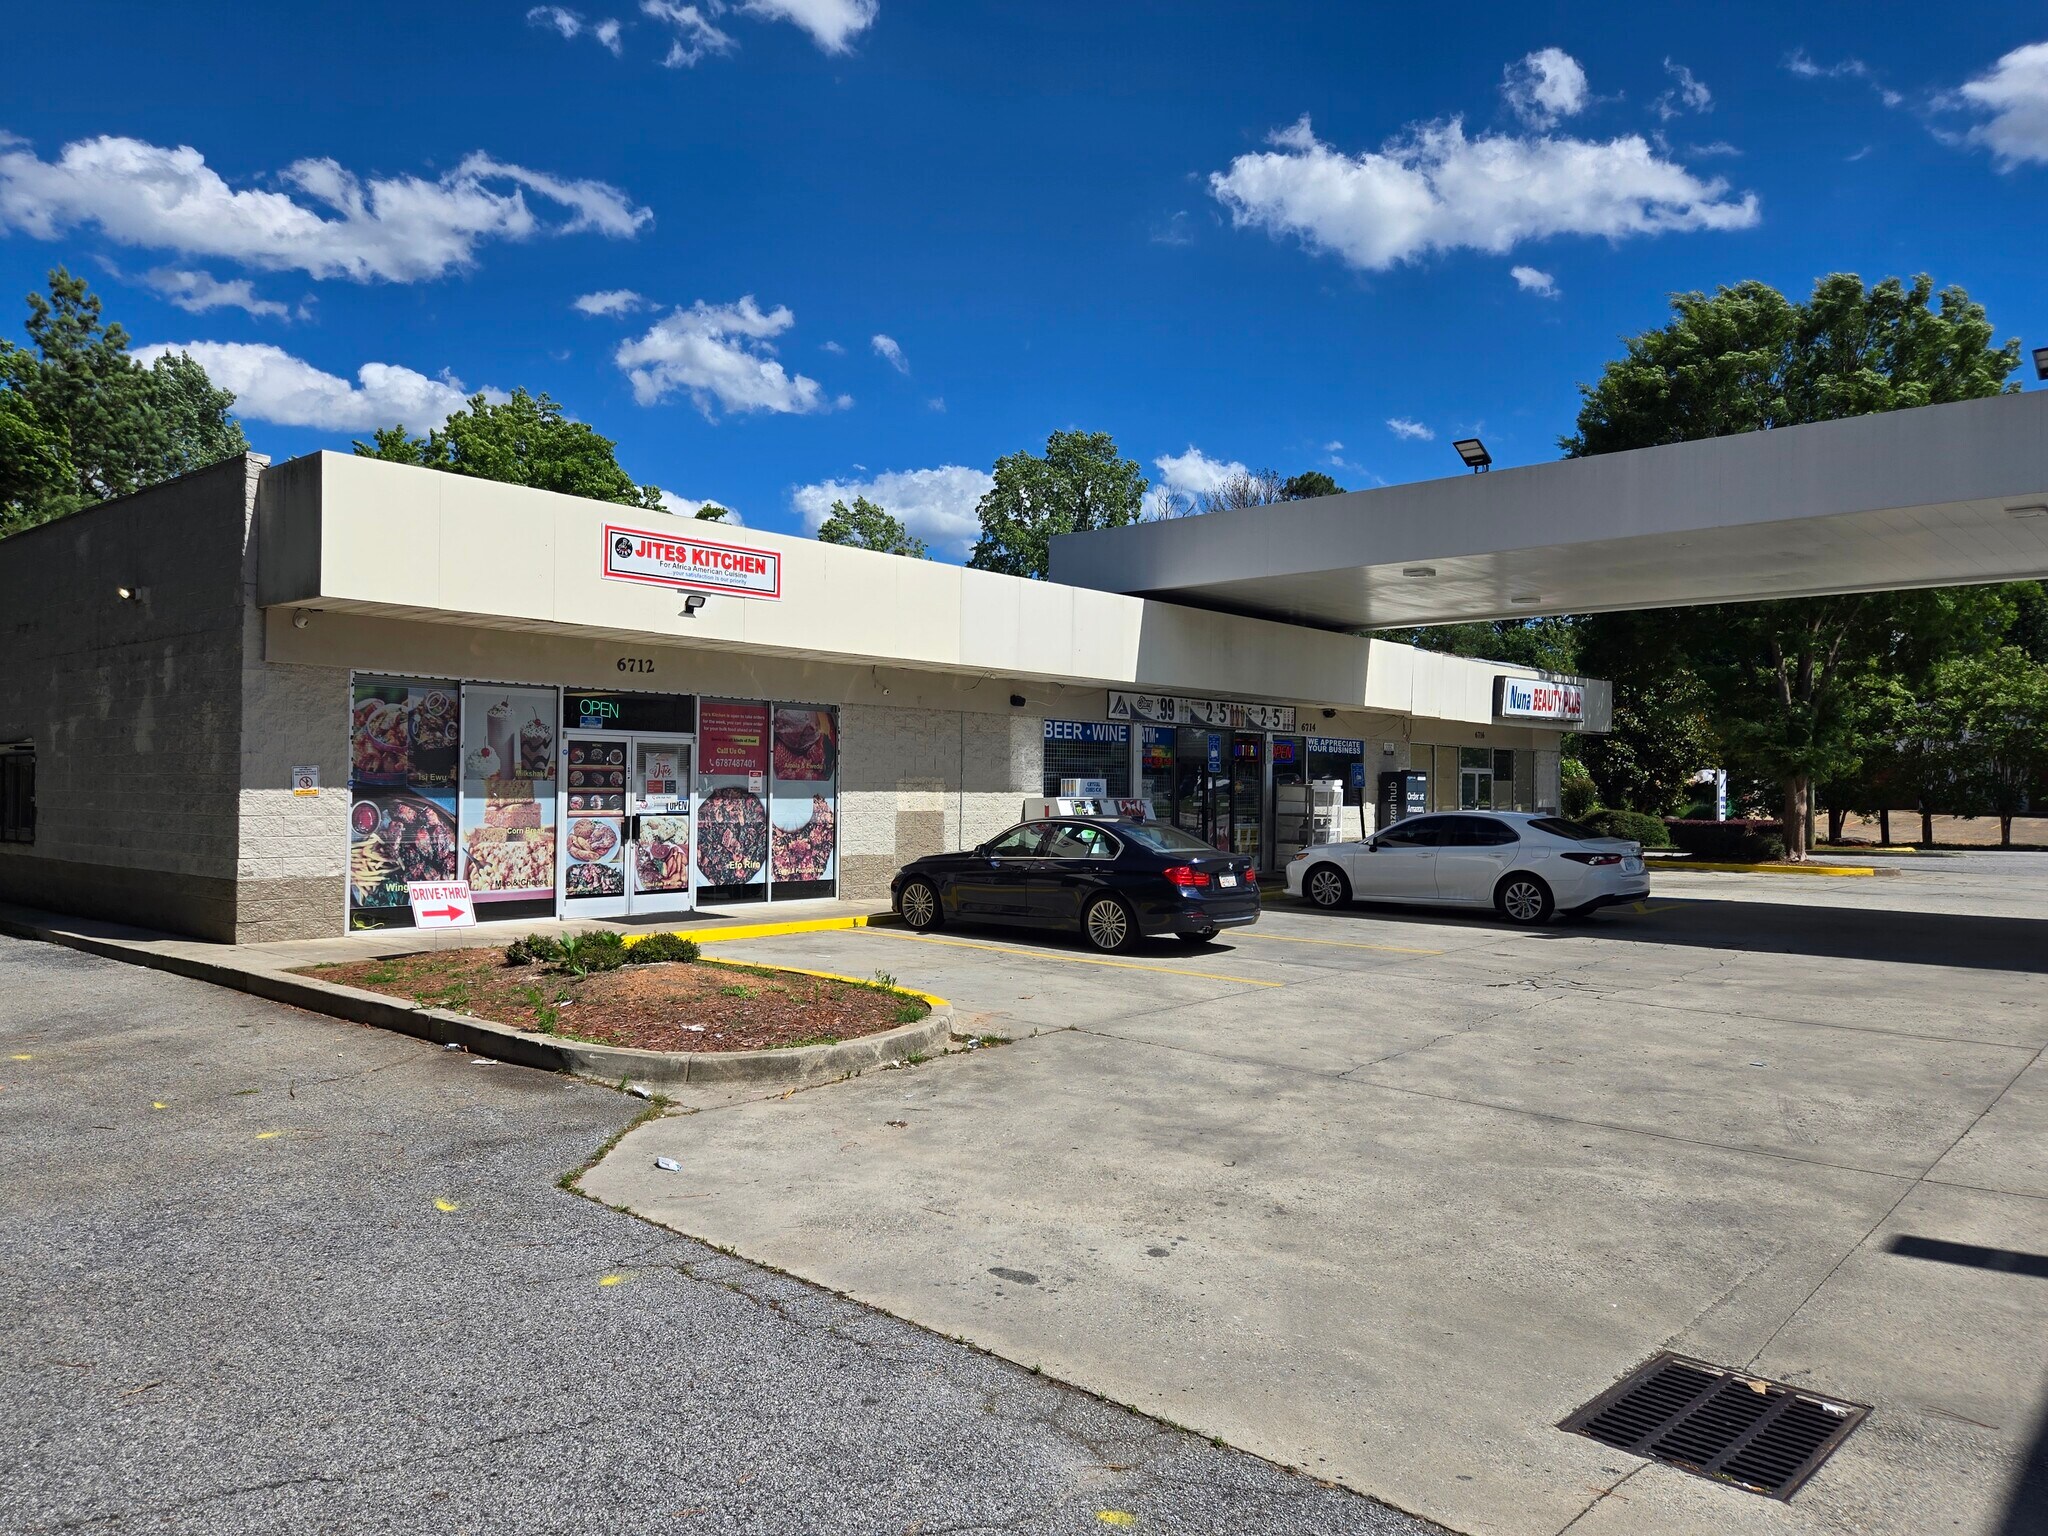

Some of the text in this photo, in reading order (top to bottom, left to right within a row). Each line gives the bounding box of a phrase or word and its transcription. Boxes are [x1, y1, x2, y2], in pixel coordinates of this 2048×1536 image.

[635, 540, 766, 575] JITES KITCHEN
[672, 562, 691, 571] Africa
[692, 565, 723, 575] American
[724, 569, 748, 579] Cuisine
[729, 578, 747, 586] priority
[616, 657, 655, 673] 6712
[1509, 685, 1581, 714] Nuna BEAUTY PLUS
[579, 699, 619, 718] OPEN
[1206, 702, 1213, 722] 2
[1260, 707, 1267, 727] 2
[1043, 720, 1127, 741] BEER WINE
[1142, 727, 1156, 743] ATM
[1301, 722, 1316, 732] 6714
[730, 747, 737, 755] Us
[1308, 738, 1360, 748] WE APPRECIATE
[1308, 744, 1361, 755] YOUR BUSINESS
[715, 758, 756, 768] 6787487401
[1388, 781, 1397, 801] hub
[1406, 791, 1419, 800] Order
[729, 860, 761, 870] Efo Riro
[412, 886, 467, 900] DRIVE-THRU
